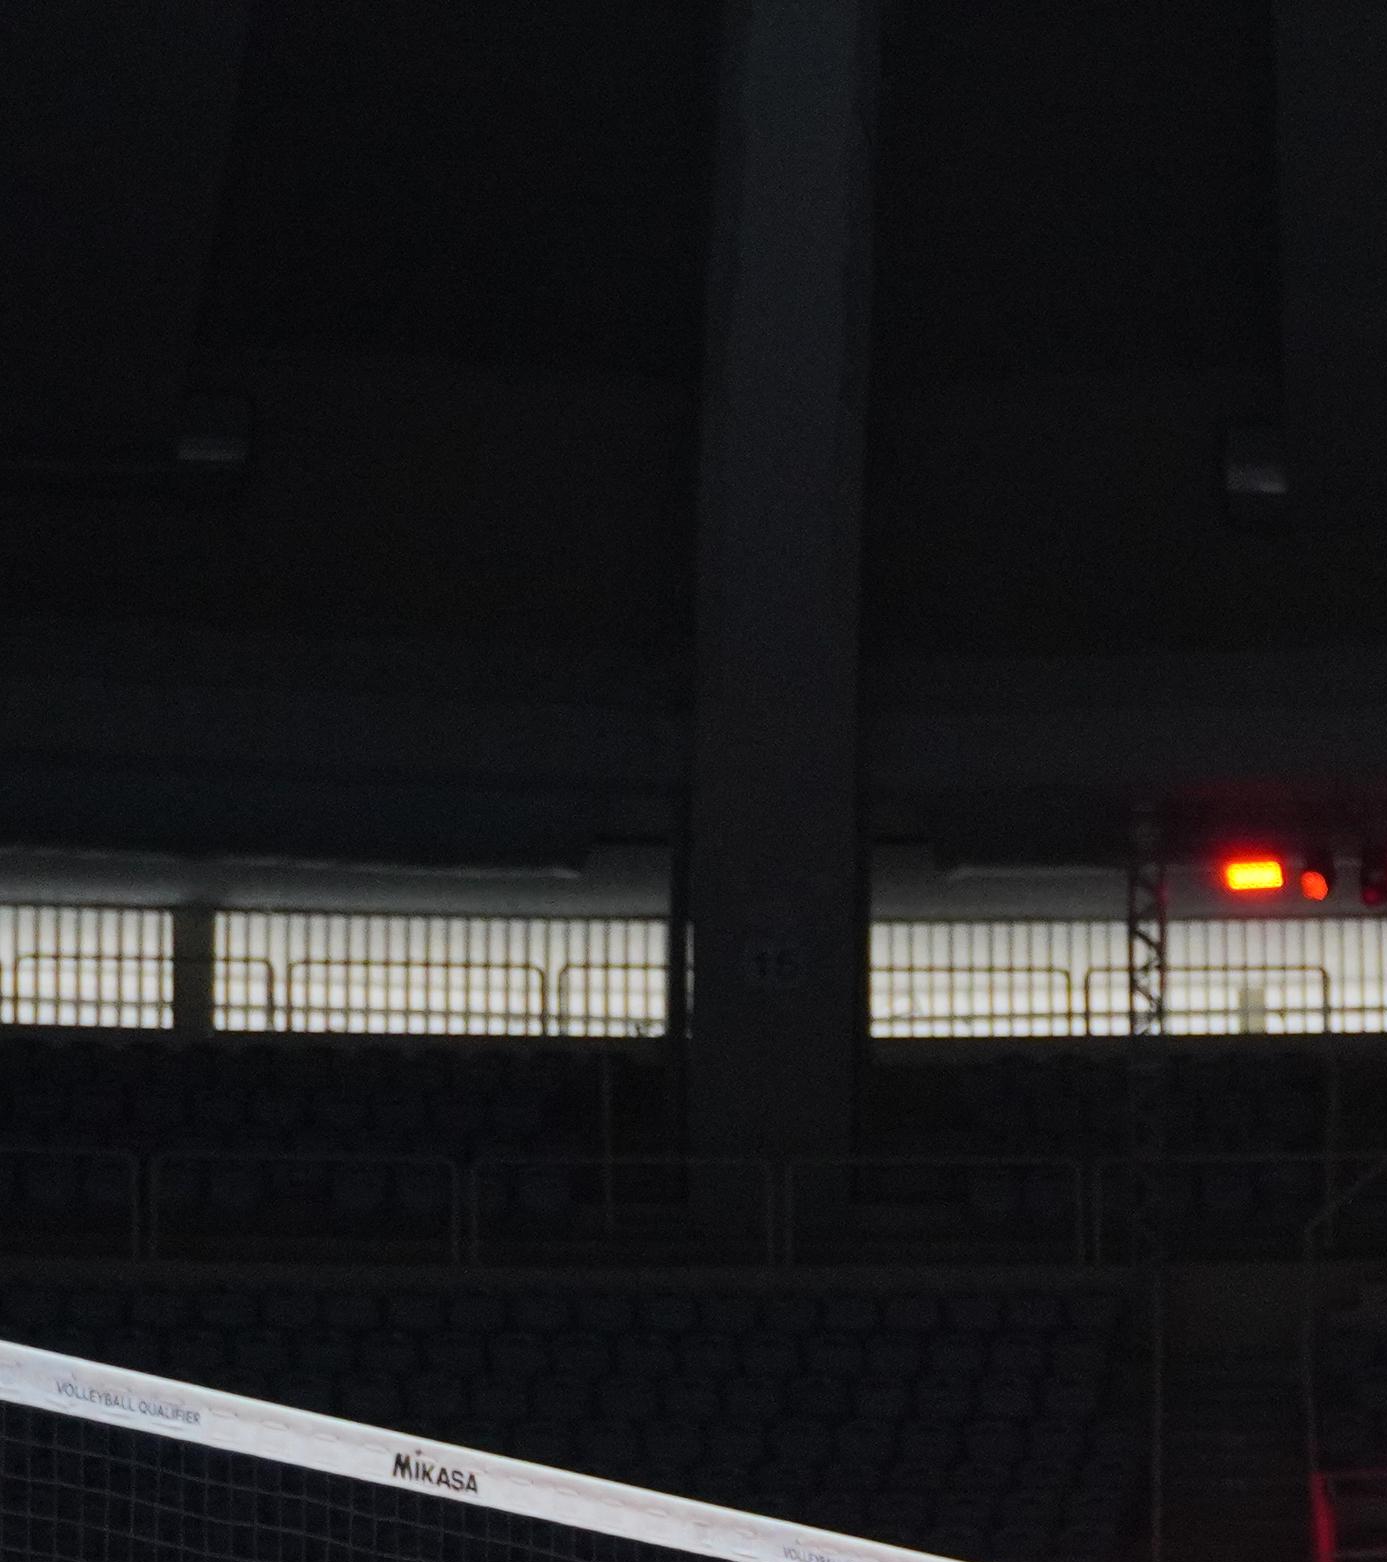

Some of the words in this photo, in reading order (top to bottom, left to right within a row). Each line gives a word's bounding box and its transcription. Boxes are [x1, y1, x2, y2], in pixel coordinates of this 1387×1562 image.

[56, 1380, 135, 1412] VOLLEYBALL
[138, 1401, 200, 1426] QUALIFIER
[392, 1449, 478, 1494] MIKASA
